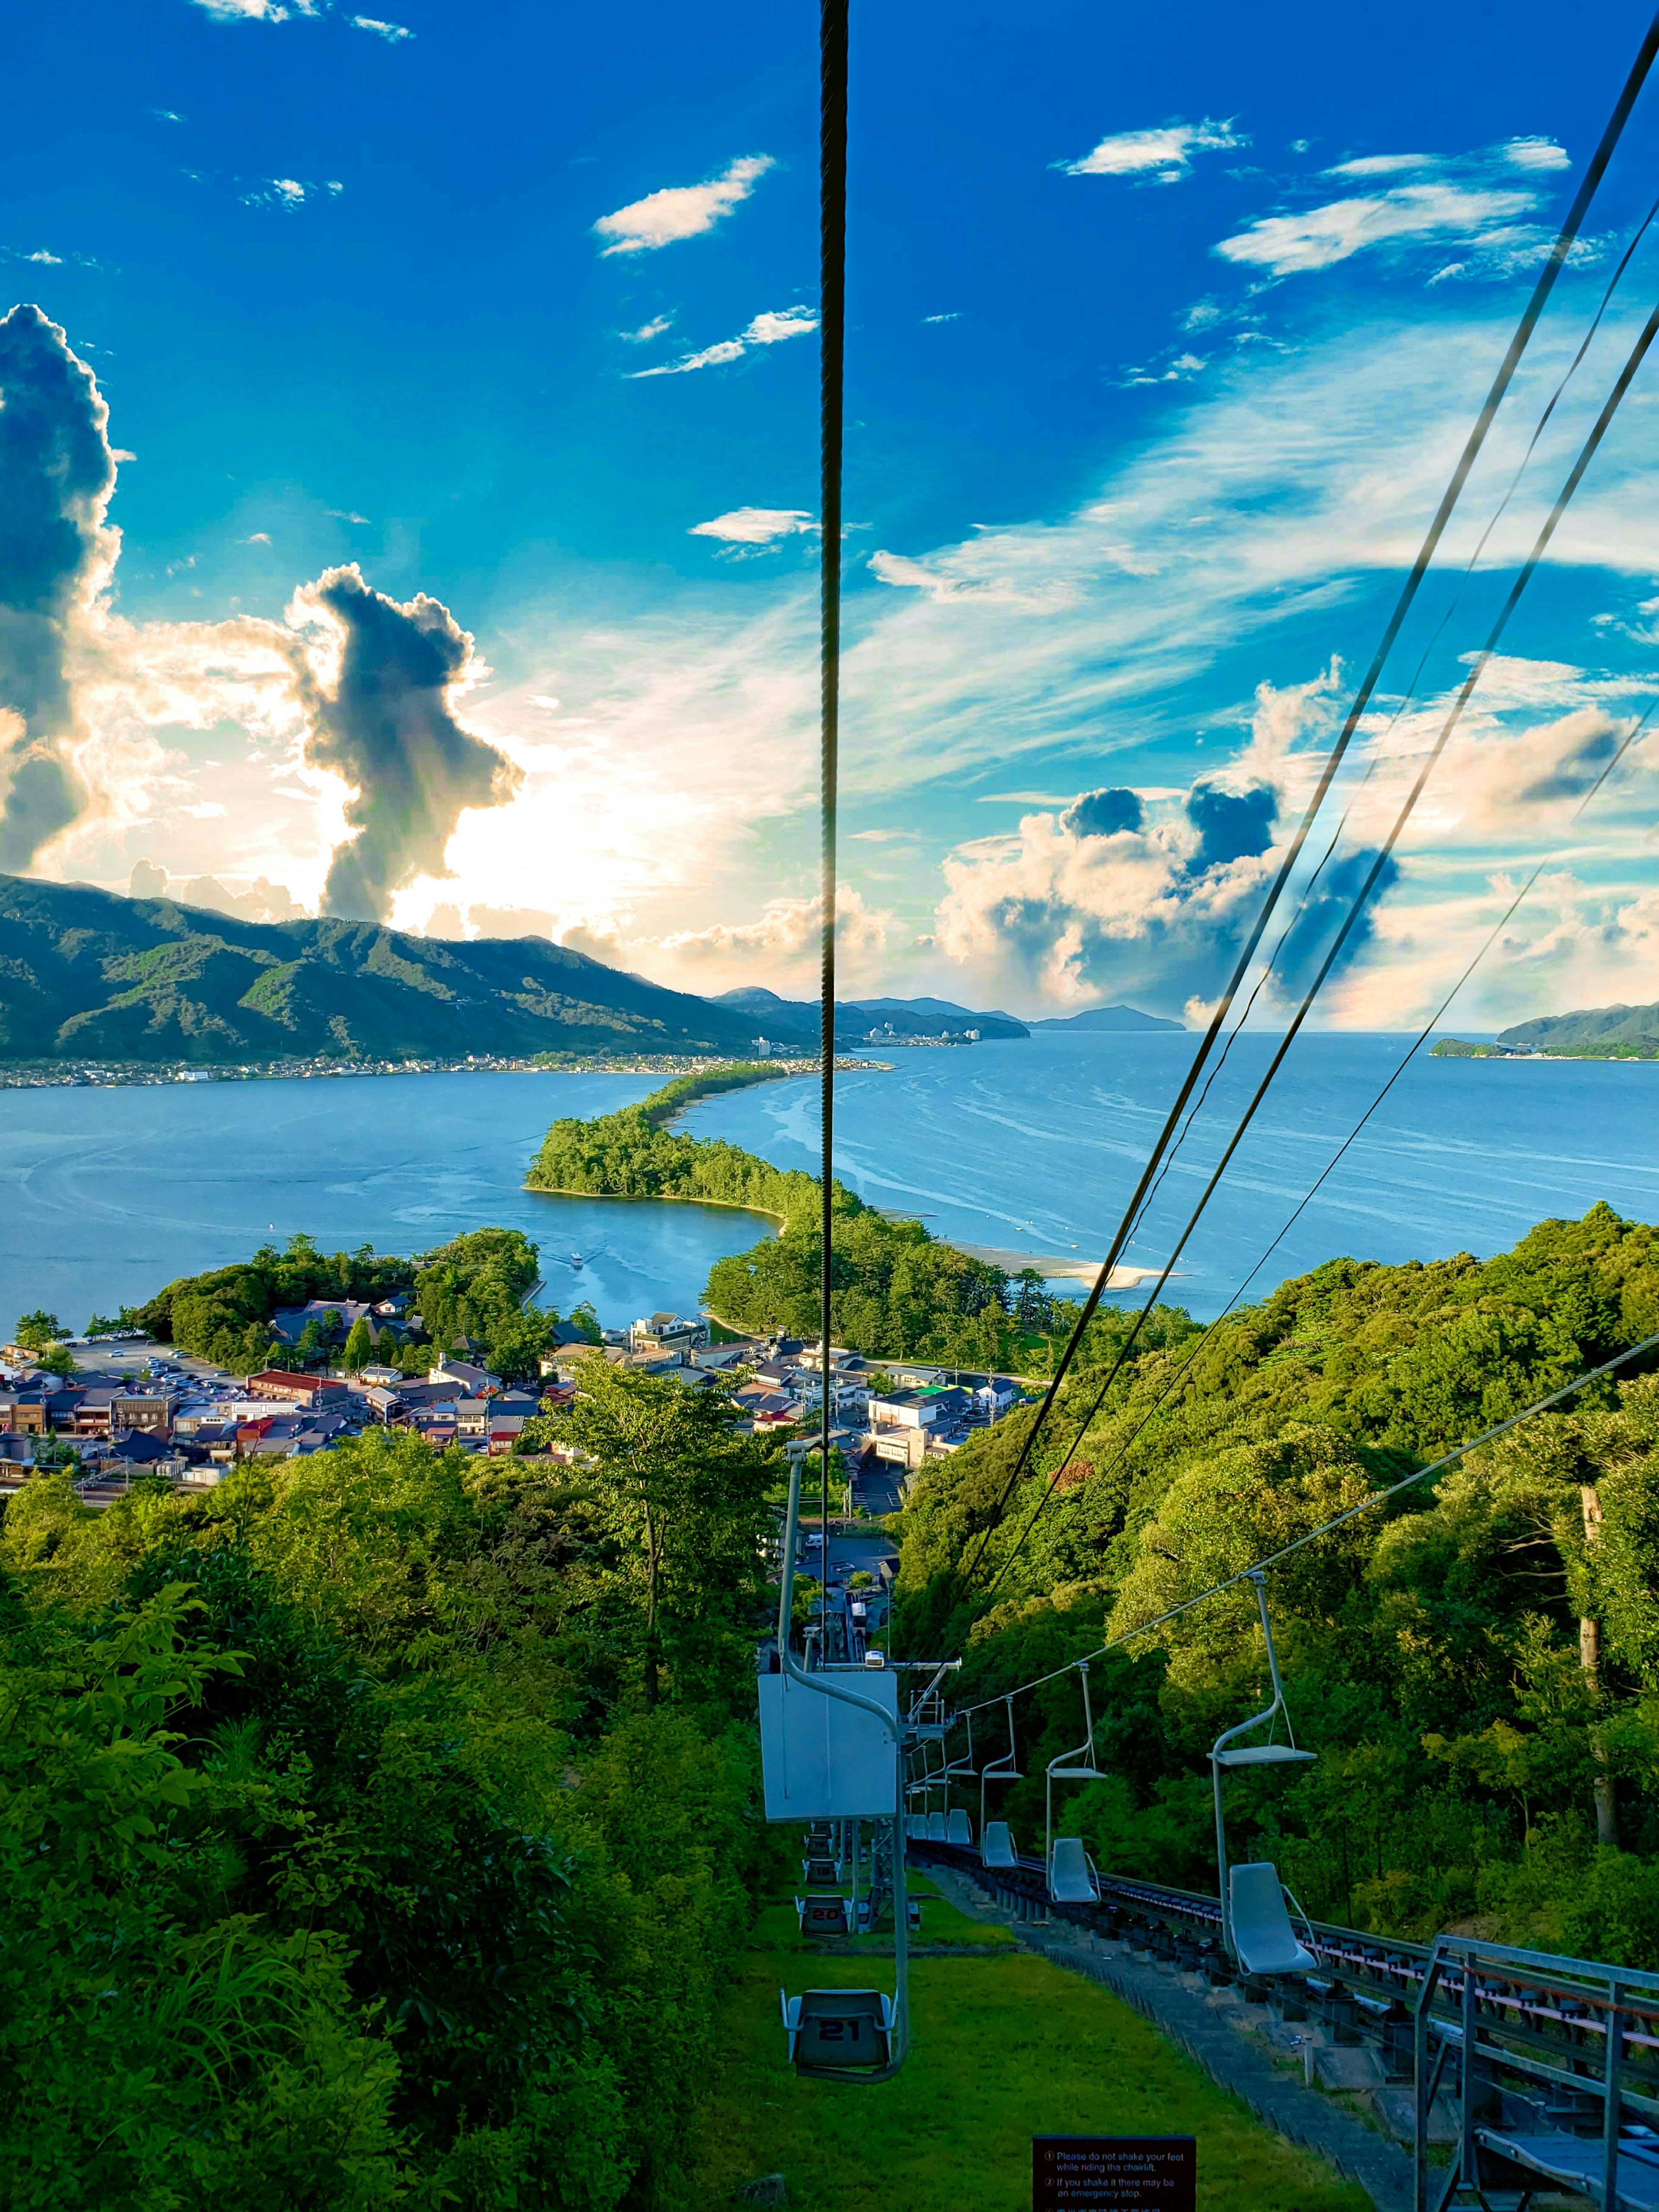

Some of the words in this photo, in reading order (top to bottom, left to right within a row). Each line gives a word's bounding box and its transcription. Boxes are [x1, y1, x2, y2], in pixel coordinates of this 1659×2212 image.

[812, 1909, 839, 1920] 20
[819, 2020, 859, 2041] 21
[1057, 2152, 1086, 2161] Please
[1089, 2152, 1099, 2161] do
[1118, 2152, 1143, 2161] shake
[1146, 2155, 1165, 2163] your
[1167, 2152, 1184, 2161] feet
[1081, 2164, 1105, 2173] riding
[1065, 2180, 1081, 2188] you
[1083, 2178, 1108, 2187] shake
[1111, 2178, 1116, 2187] it
[1118, 2178, 1140, 2187] there
[1143, 2180, 1161, 2188] may
[1163, 2178, 1174, 2187] be
[1071, 2190, 1119, 2199] emergency
[1121, 2190, 1141, 2199] stop.
